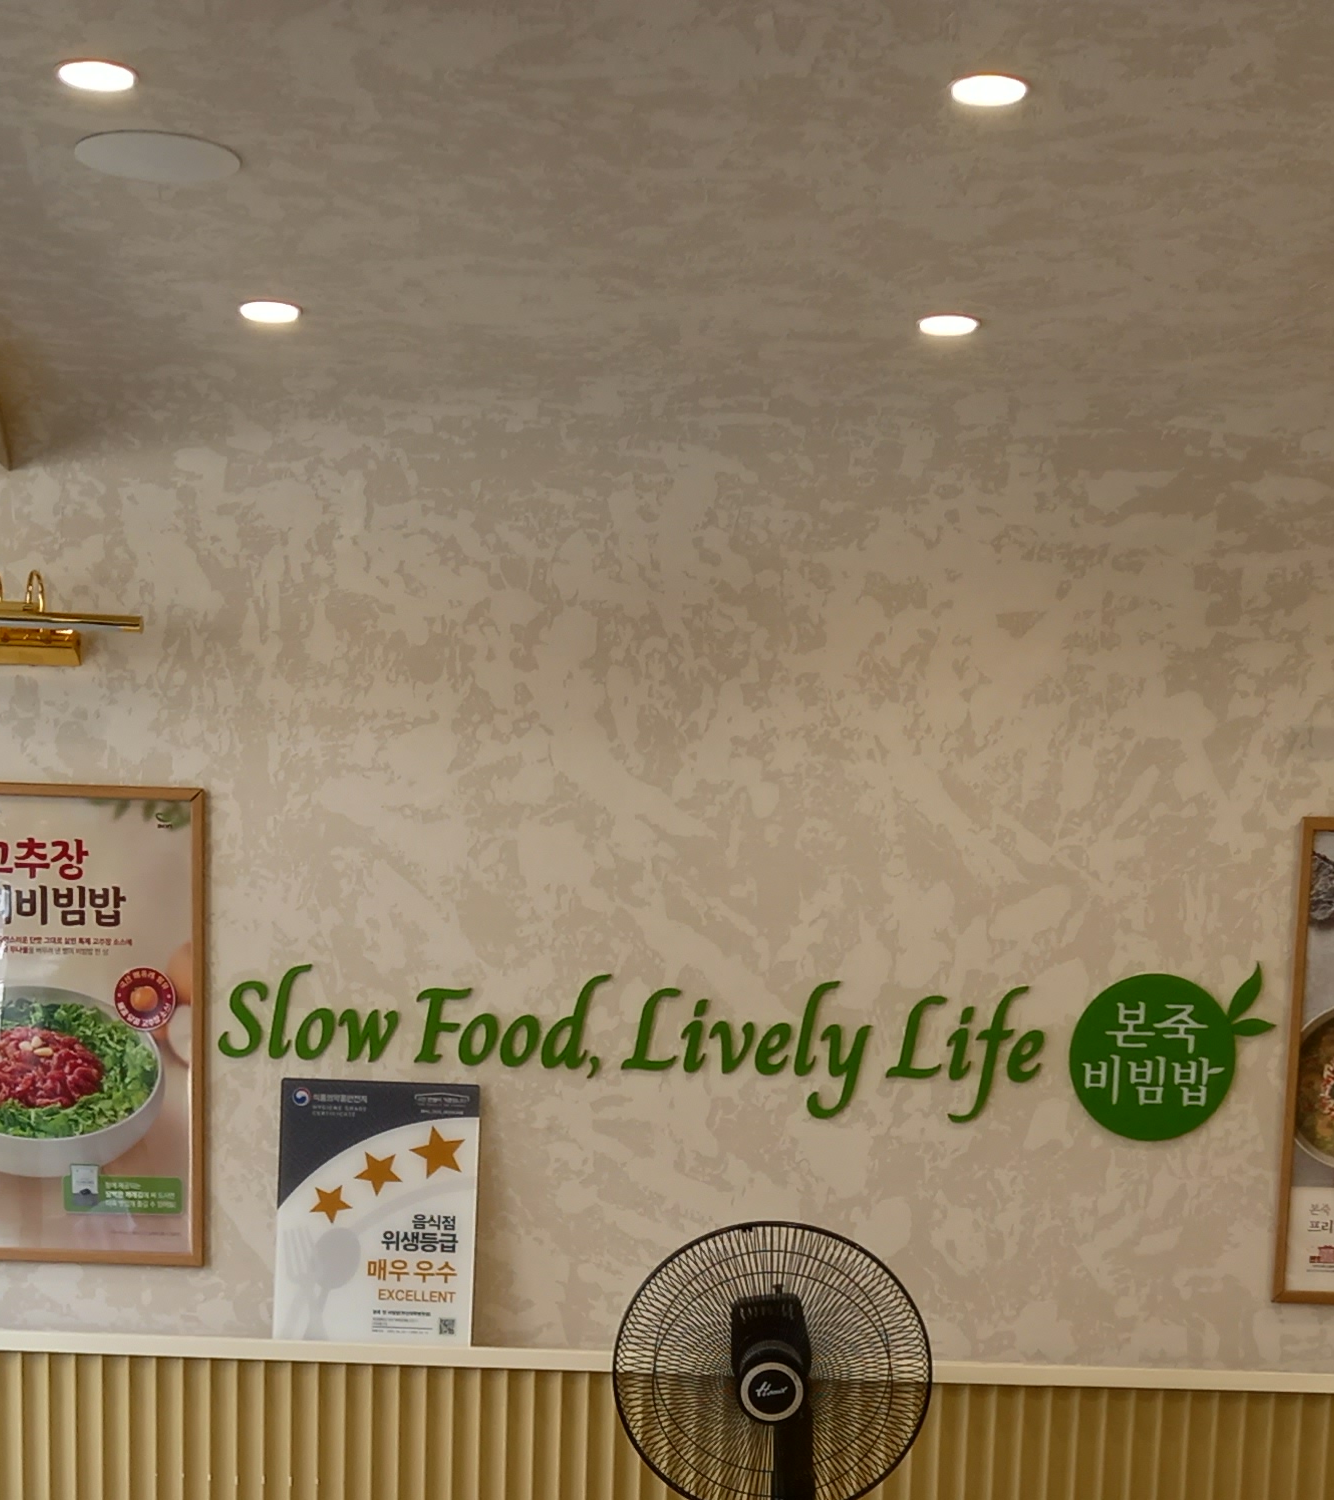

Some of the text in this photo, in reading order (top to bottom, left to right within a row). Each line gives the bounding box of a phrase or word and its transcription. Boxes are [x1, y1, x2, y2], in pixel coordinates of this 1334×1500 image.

[1105, 1001, 1209, 1054] 본죽
[218, 963, 1046, 1124] Slow Food, Lively Life
[1082, 1054, 1226, 1108] 비빔밥
[412, 1213, 456, 1231] 음식점
[1309, 1204, 1331, 1216] 본죽
[381, 1230, 459, 1253] 위생등급
[367, 1258, 458, 1284] 매우 우수
[378, 1288, 457, 1303] EXCELLENT
